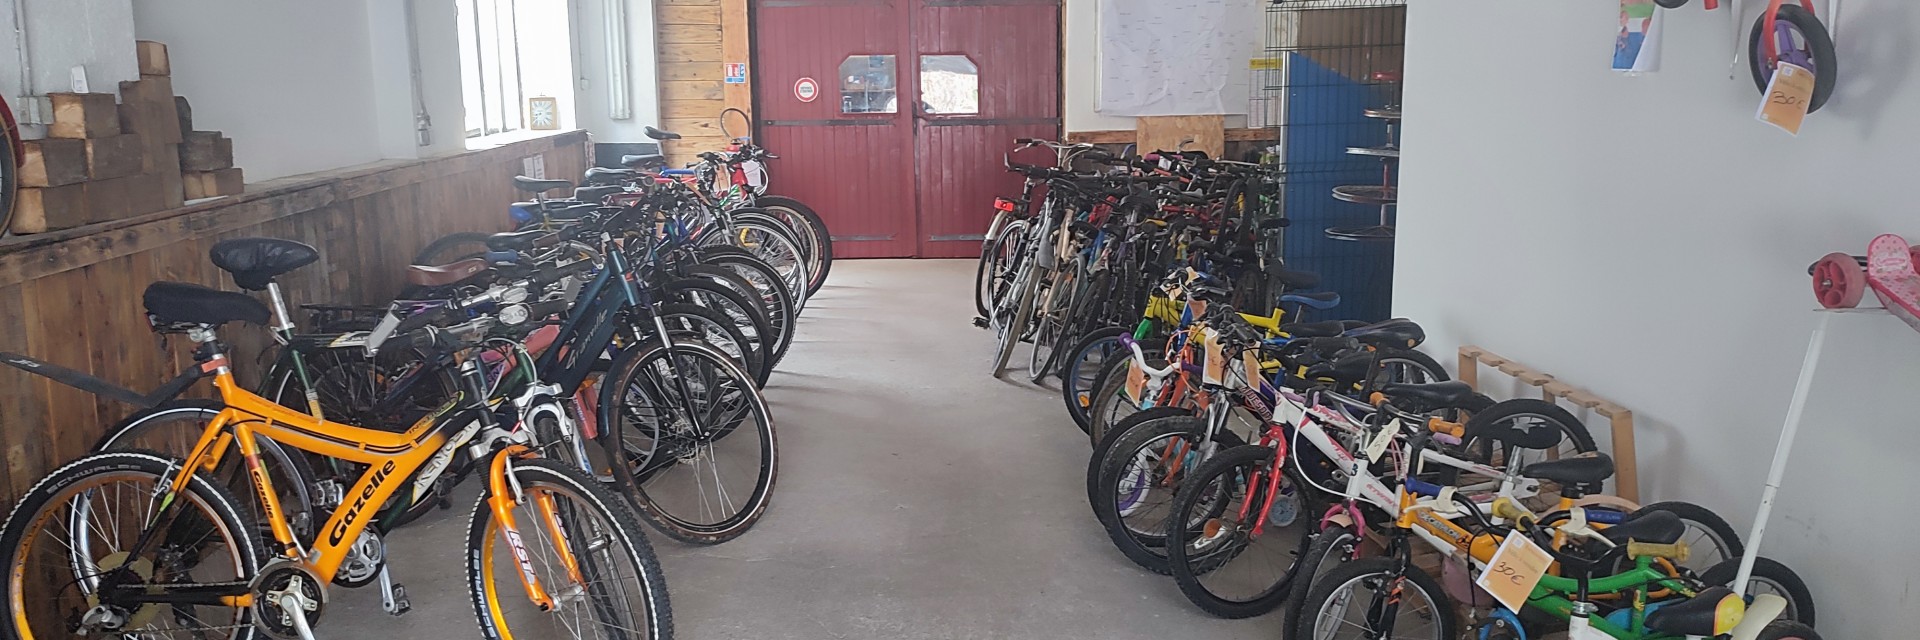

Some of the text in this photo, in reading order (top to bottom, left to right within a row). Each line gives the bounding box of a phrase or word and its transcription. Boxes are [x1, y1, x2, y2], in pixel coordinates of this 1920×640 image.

[253, 470, 274, 519] Gazelle
[329, 459, 396, 547] Gazelle
[508, 530, 536, 575] RST
[473, 548, 497, 638] SCHWALBE
